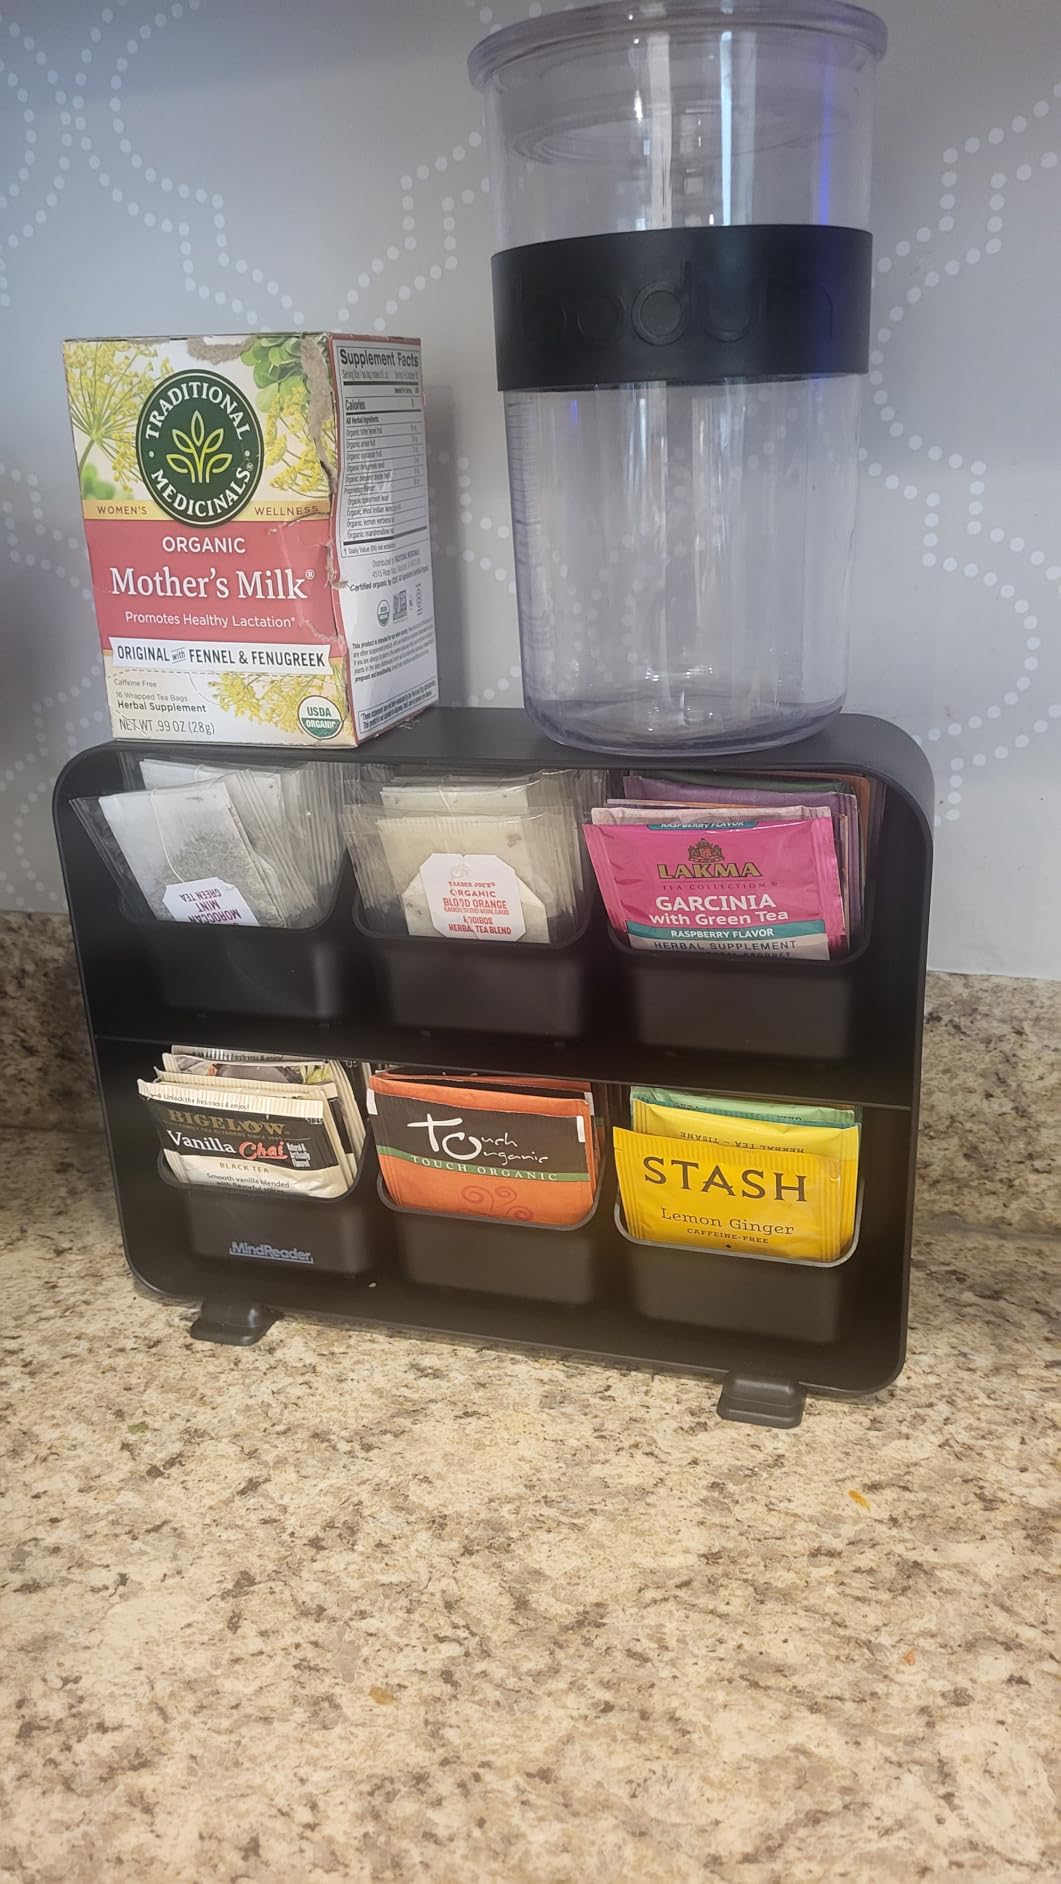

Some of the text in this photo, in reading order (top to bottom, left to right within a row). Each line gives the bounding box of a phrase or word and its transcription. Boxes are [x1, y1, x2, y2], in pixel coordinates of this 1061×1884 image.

[340, 348, 419, 368] Supplement Facts
[145, 381, 251, 441] TRADITIONAL
[345, 399, 366, 411] Calories
[97, 505, 319, 516] WOMEN'S WELLNESS
[162, 536, 246, 554] ORGANIC
[110, 566, 230, 598] Mother's
[350, 583, 371, 592] Certified
[125, 611, 180, 625] Promotes
[183, 614, 229, 628] Healthy
[117, 645, 326, 667] ORIGINAL with FENNEL & FENUGREEK
[114, 678, 157, 688] Caffeine Free
[116, 691, 188, 703] 16 Wrapped Tea Bags
[118, 700, 207, 715] Herbal Supplement
[307, 707, 332, 717] USDA
[119, 718, 138, 730] NET
[138, 719, 153, 732] WT
[172, 721, 187, 733] OZ
[188, 720, 215, 735] (28g)
[305, 719, 337, 729] ORGANIC
[656, 862, 763, 879] LAKMA
[450, 889, 497, 898] ORGANIC
[663, 881, 766, 891] TEA COLLECTION
[179, 888, 222, 903] GREEN TEA
[655, 893, 777, 912] GARCINIA
[195, 899, 221, 913] MINT
[443, 897, 471, 908] BLOOD
[473, 899, 508, 910] ORANGE
[188, 909, 242, 923] MOROCCAN
[649, 910, 789, 926] with Green Tea
[475, 925, 489, 934] TEA
[489, 926, 512, 935] BLEND
[670, 928, 774, 939] RASPBERRY FLAVOR
[654, 940, 797, 950] HERBAL SUPPLEMENT
[168, 1109, 286, 1136] BIGELOW
[167, 1130, 237, 1154] Vanilla
[239, 1141, 288, 1160] Chai
[680, 1131, 720, 1144] TISANE
[734, 1140, 755, 1150] TEA
[219, 1162, 270, 1174] BLACK TEA
[410, 1155, 558, 1181] TOUCH ORGANIC
[206, 1173, 290, 1189] Smooth vanilla blended
[643, 1156, 808, 1203] STASH
[661, 1207, 795, 1237] Lemon Ginger
[687, 1228, 769, 1244] CAFFEINE-FREE
[231, 1241, 311, 1261] MindReader
